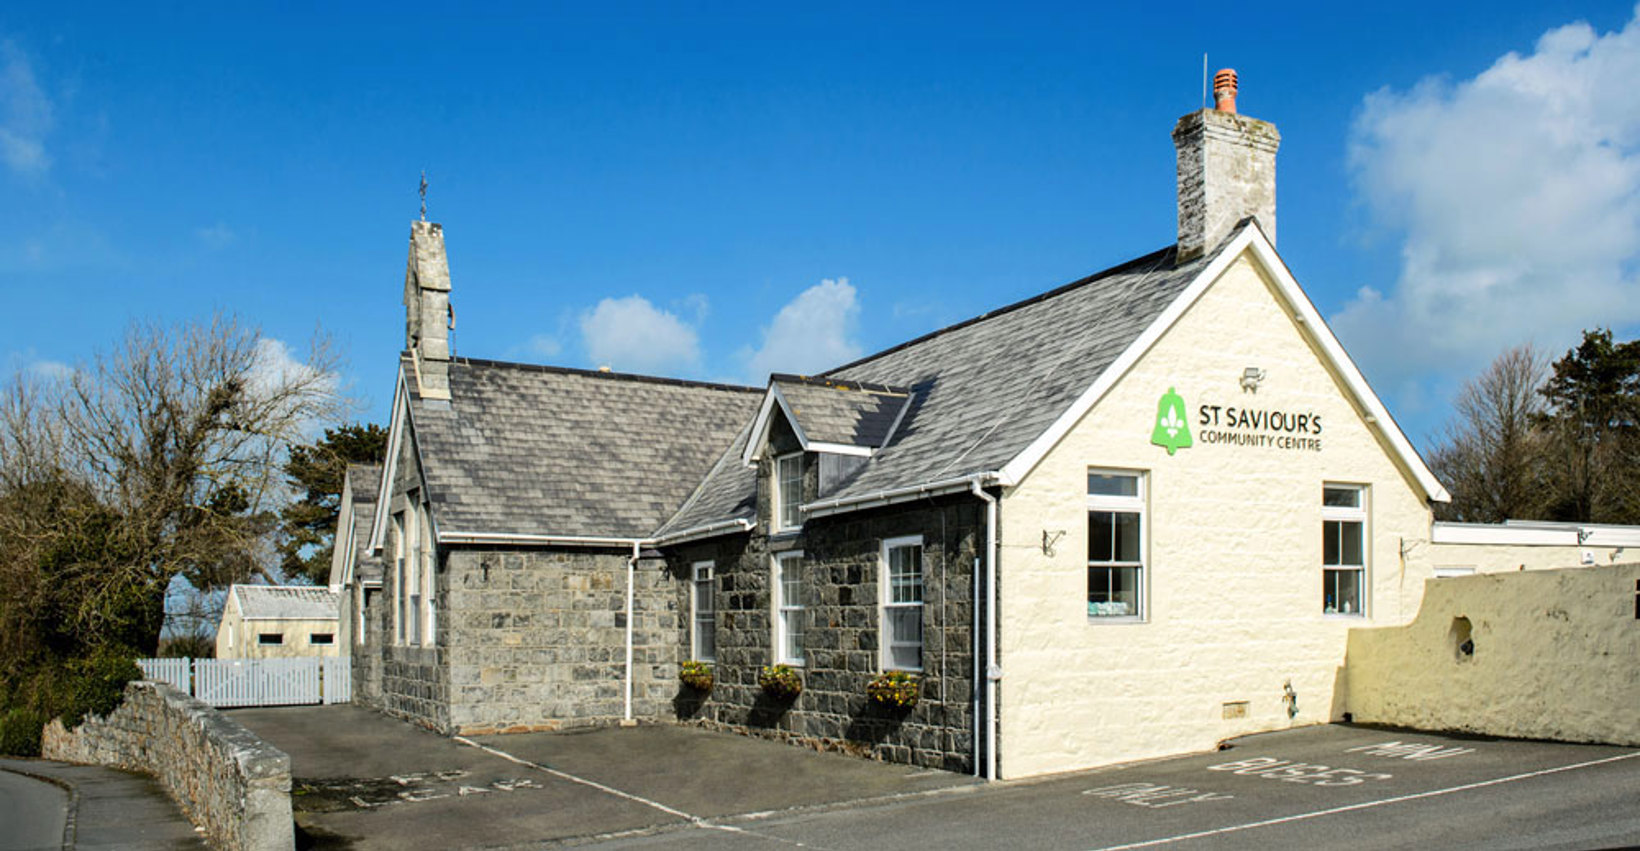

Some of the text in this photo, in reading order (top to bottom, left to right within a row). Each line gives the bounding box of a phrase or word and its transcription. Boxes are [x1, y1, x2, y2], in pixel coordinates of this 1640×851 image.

[1199, 405, 1322, 434] ST SAVIOUR'S
[1200, 431, 1322, 452] COMMUNITY CENTRE
[1206, 756, 1394, 787] BUSES
[1082, 783, 1235, 808] ONLY
